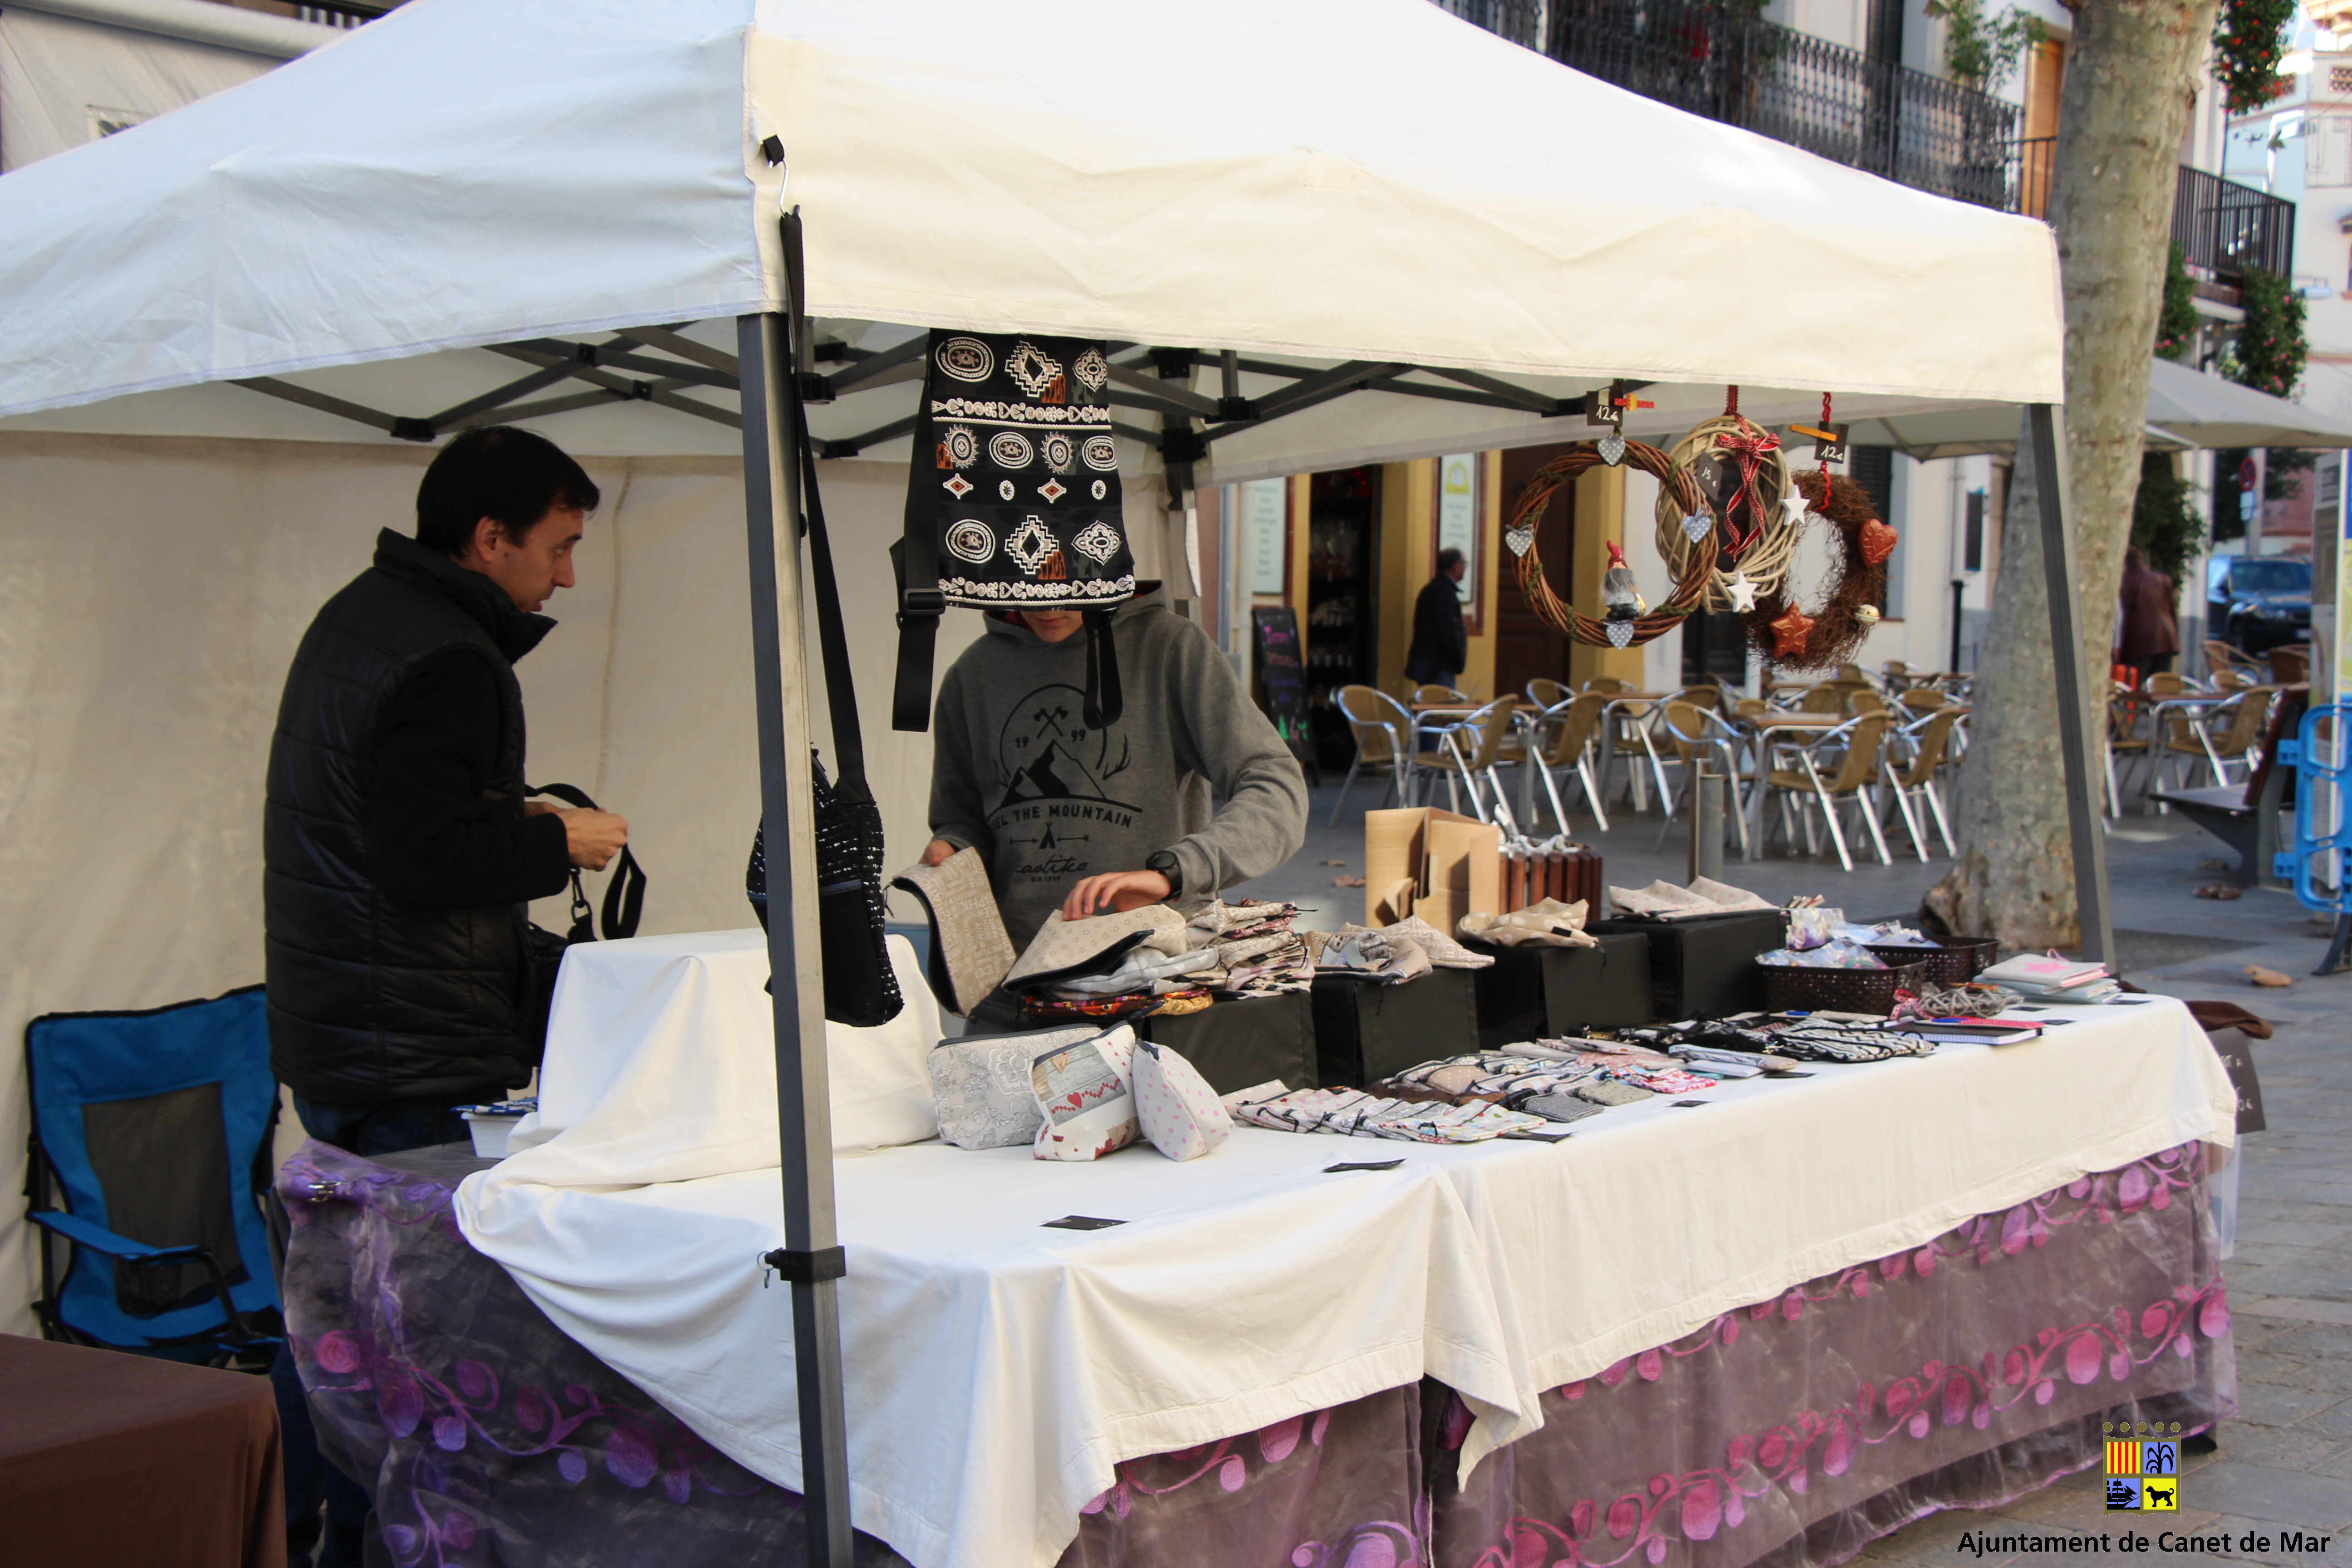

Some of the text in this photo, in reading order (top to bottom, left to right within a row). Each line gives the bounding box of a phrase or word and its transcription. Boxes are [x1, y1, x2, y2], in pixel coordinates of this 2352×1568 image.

[1596, 405, 1619, 421] 12€
[1820, 445, 1843, 461] 12€
[1015, 729, 1086, 749] 19 99
[1012, 806, 1041, 822] THE
[1049, 804, 1132, 828] MOUNTAIN
